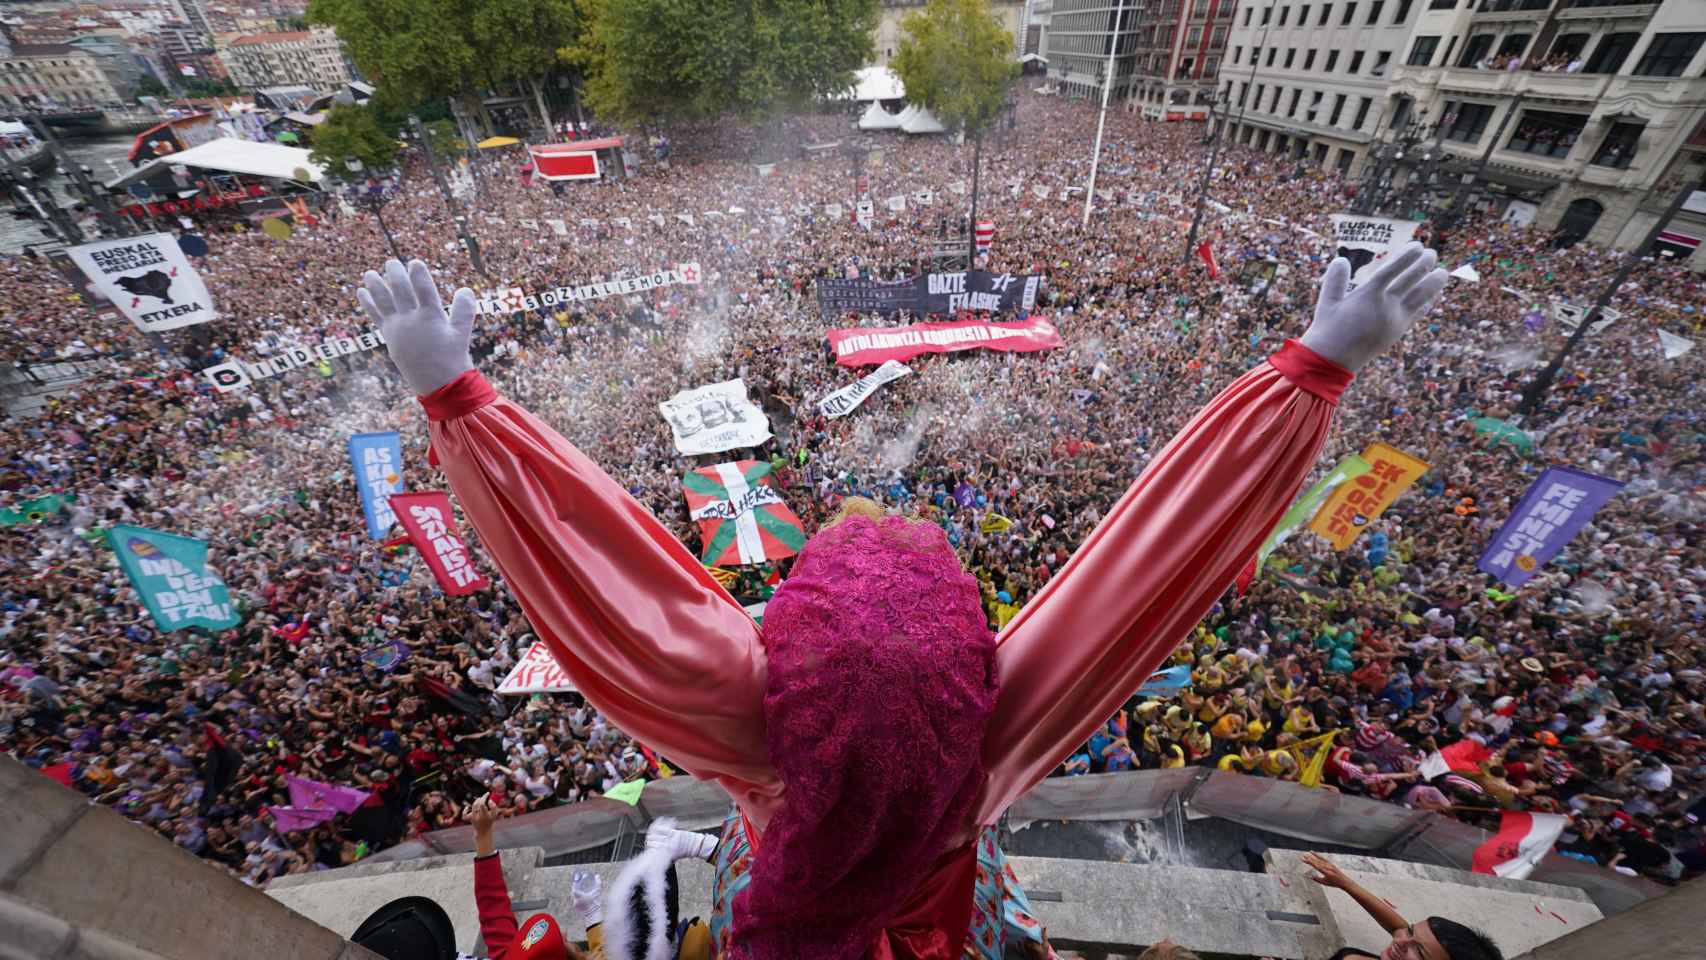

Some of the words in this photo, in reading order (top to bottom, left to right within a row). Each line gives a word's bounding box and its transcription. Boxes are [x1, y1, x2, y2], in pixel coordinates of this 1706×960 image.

[1339, 221, 1395, 232] EUSKAL
[90, 242, 159, 261] EUSKAL
[140, 250, 163, 261] ETA
[526, 273, 676, 309] SOZIALISMOA
[927, 272, 967, 295] GAZTE
[140, 302, 205, 323] ETXERA
[363, 447, 391, 464] AS
[1371, 459, 1408, 483] EK
[1354, 474, 1390, 499] OL
[1543, 483, 1589, 509] FE
[1347, 489, 1379, 515] OG
[1528, 500, 1575, 527] MI
[1516, 517, 1555, 541] NI
[1503, 533, 1545, 556] ST
[440, 550, 466, 572] IS
[1490, 549, 1515, 569] A
[450, 564, 480, 588] TA
